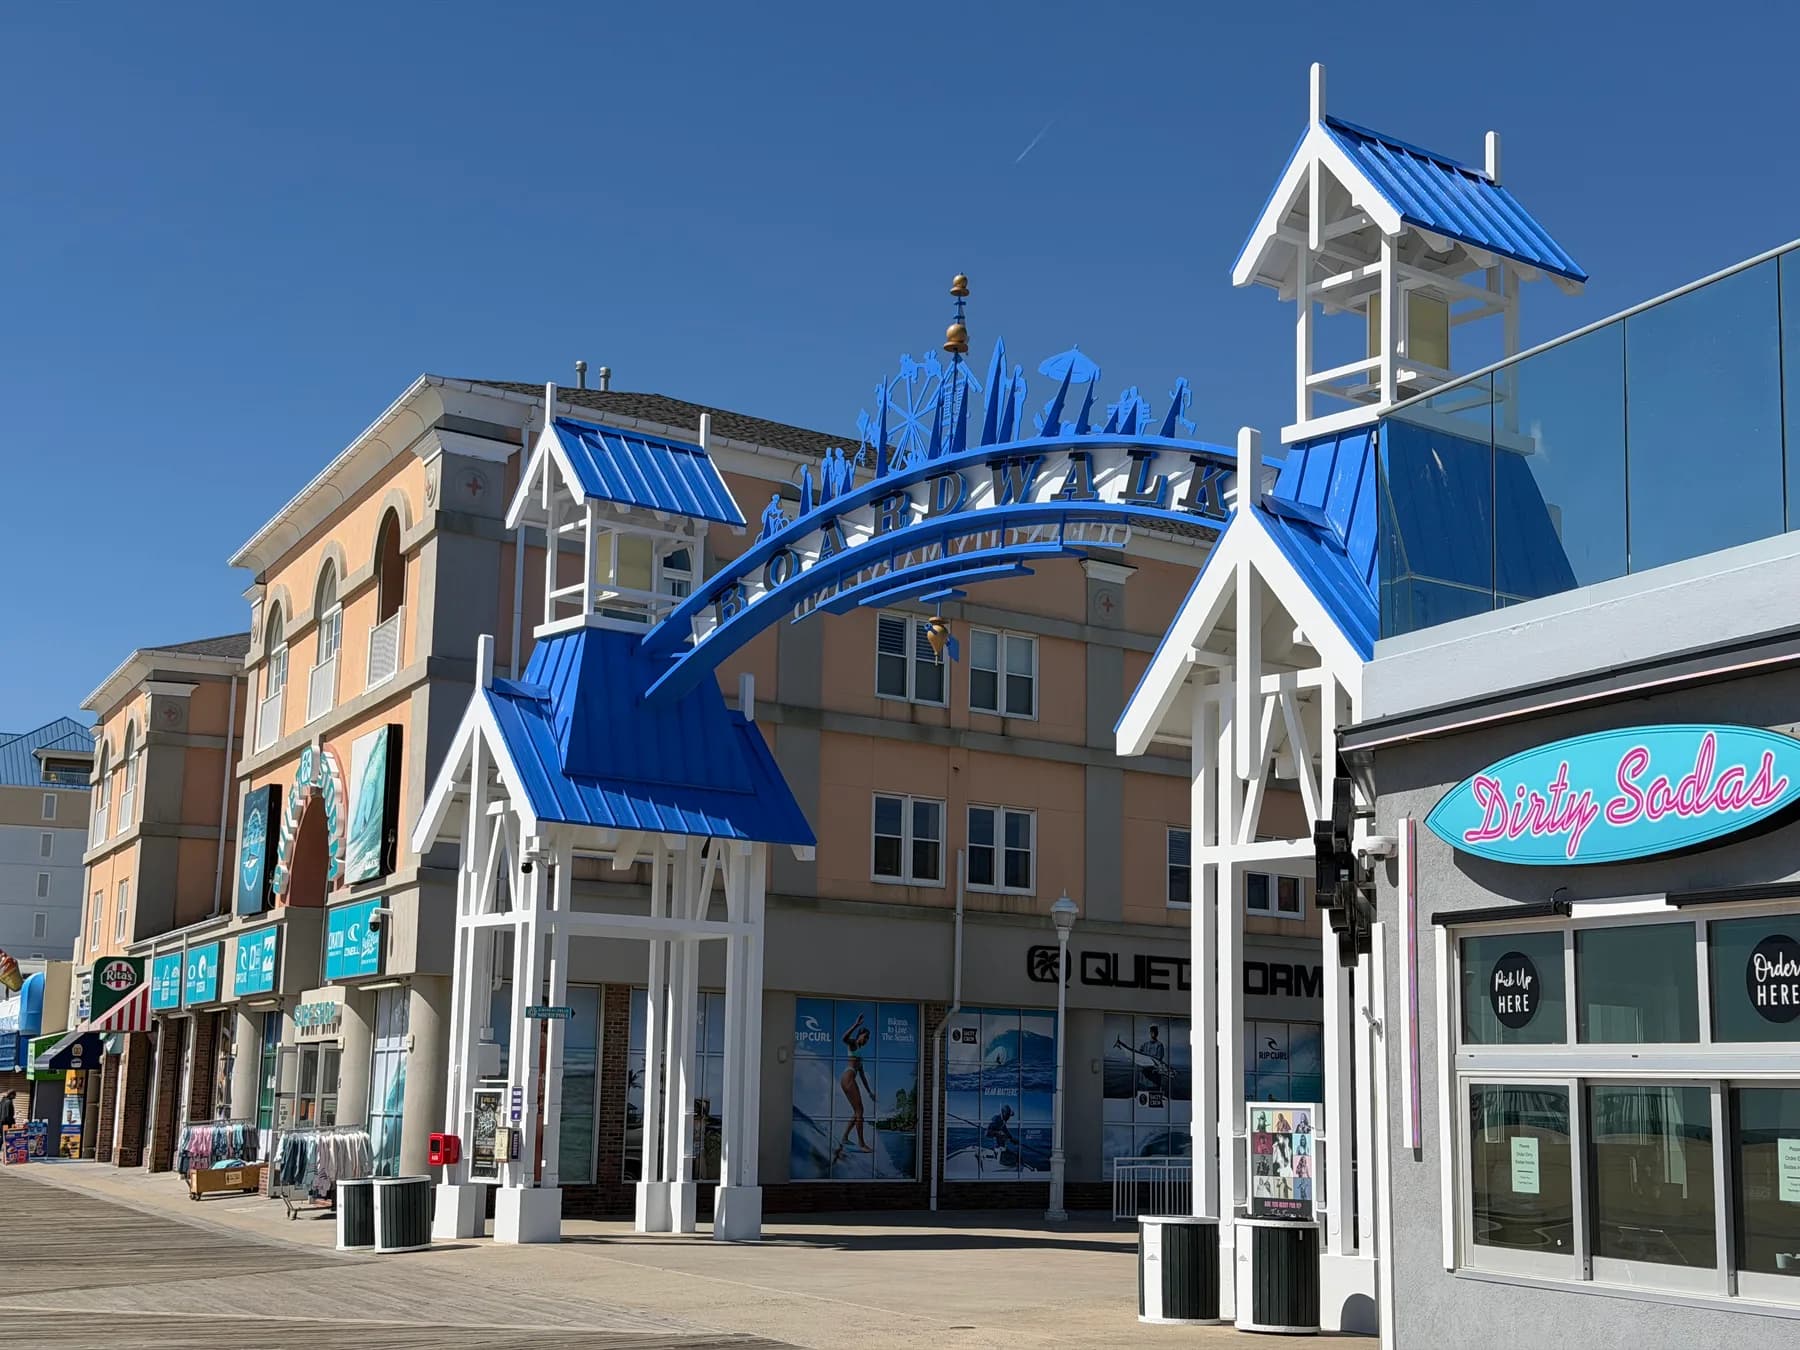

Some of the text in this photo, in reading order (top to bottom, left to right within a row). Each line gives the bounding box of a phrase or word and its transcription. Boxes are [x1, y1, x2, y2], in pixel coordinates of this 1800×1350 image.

[711, 448, 1236, 628] BOARDWALK
[1463, 732, 1788, 859] Dirty Sodas
[106, 969, 133, 981] Rita's
[1243, 960, 1324, 998] ORM
[1495, 967, 1533, 992] Pick Up
[1753, 951, 1800, 982] Order
[1498, 994, 1530, 1013] HERE
[1757, 983, 1800, 1006] HERE
